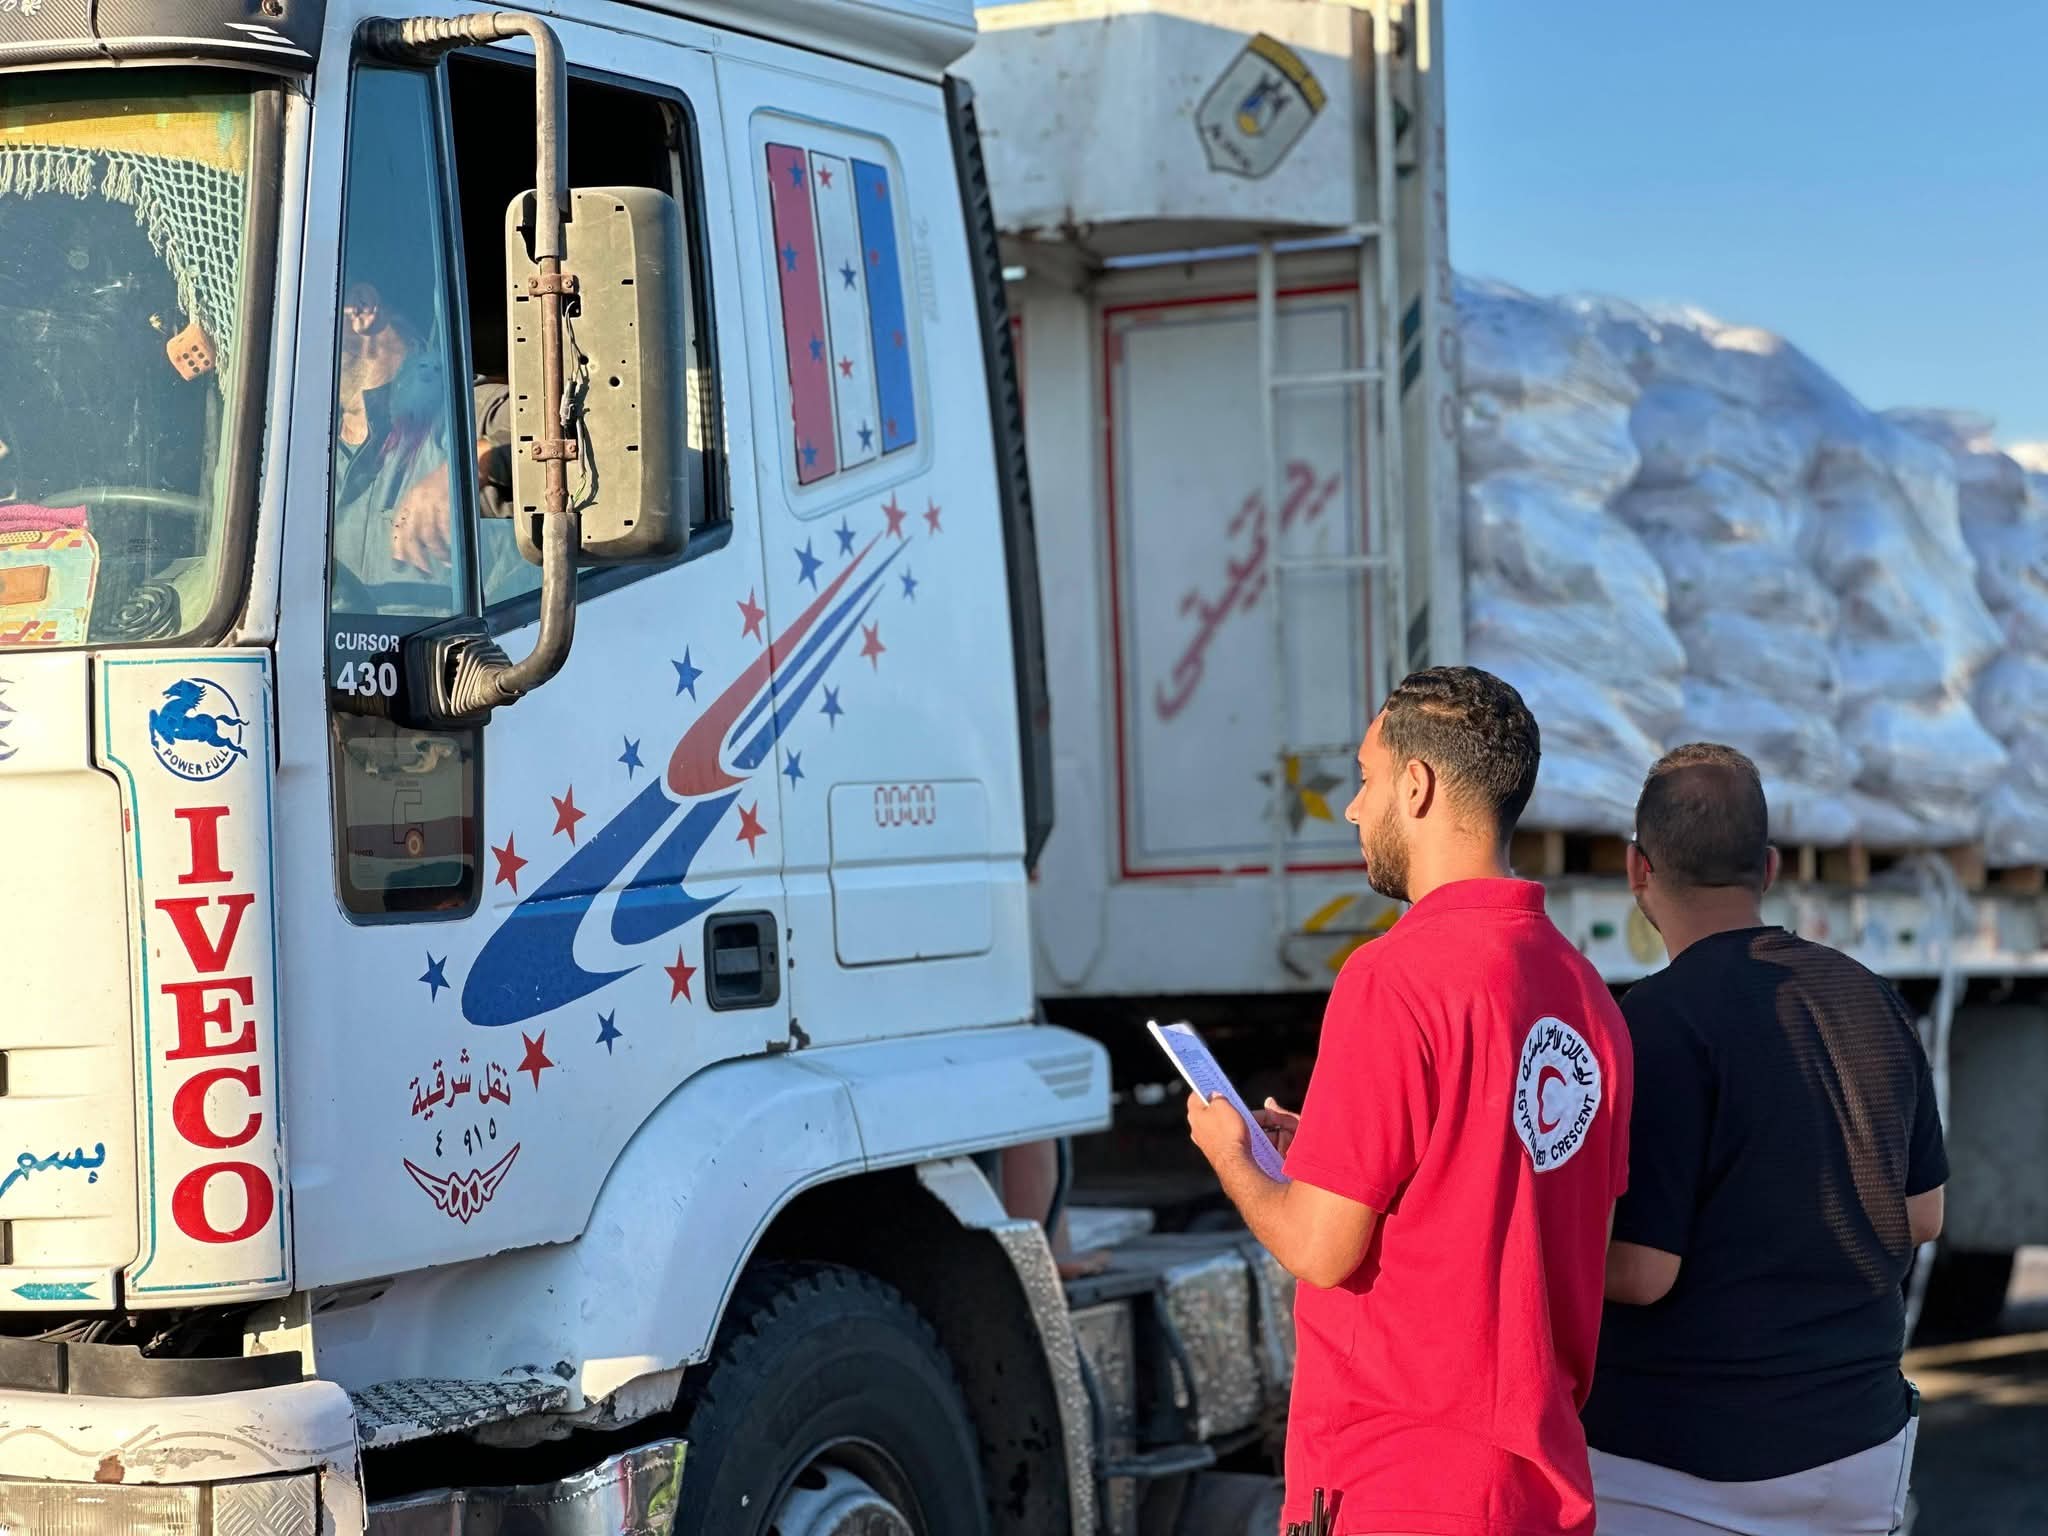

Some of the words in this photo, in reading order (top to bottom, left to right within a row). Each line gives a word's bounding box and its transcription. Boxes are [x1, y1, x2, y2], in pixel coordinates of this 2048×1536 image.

[335, 631, 400, 653] CURSOR
[337, 661, 398, 697] 430
[162, 747, 204, 776] POWER
[205, 749, 230, 774] FULL
[155, 805, 275, 1245] IVECO
[408, 1048, 472, 1121] شرقية
[478, 1061, 511, 1106] نقل
[1550, 1093, 1595, 1161] CRESCENT
